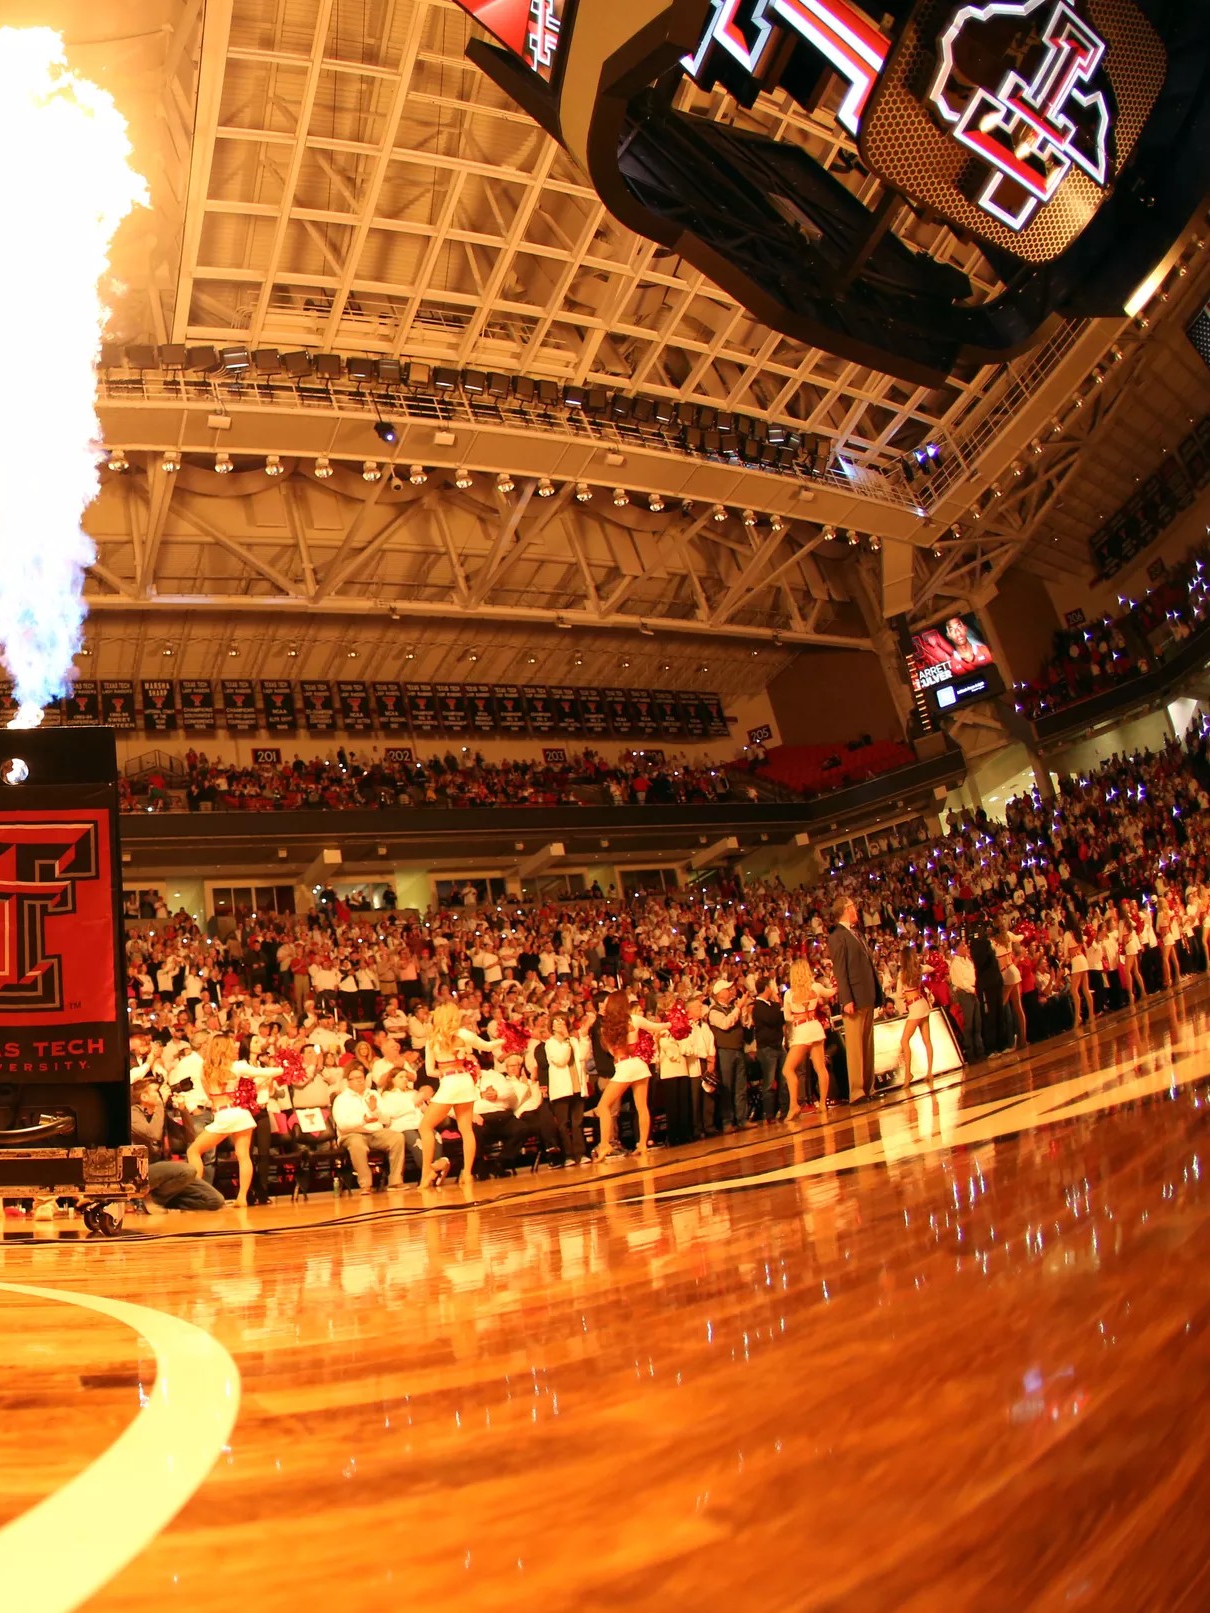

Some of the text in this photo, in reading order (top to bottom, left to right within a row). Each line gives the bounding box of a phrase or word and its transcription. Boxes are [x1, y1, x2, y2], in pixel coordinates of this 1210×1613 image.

[915, 660, 953, 681] ARRETT
[144, 682, 170, 690] MARSHA
[750, 728, 770, 743] 205
[257, 751, 277, 763] 201
[387, 751, 410, 762] 202
[545, 751, 564, 763] 203
[69, 1002, 82, 1010] TM
[33, 1038, 105, 1057] TECH
